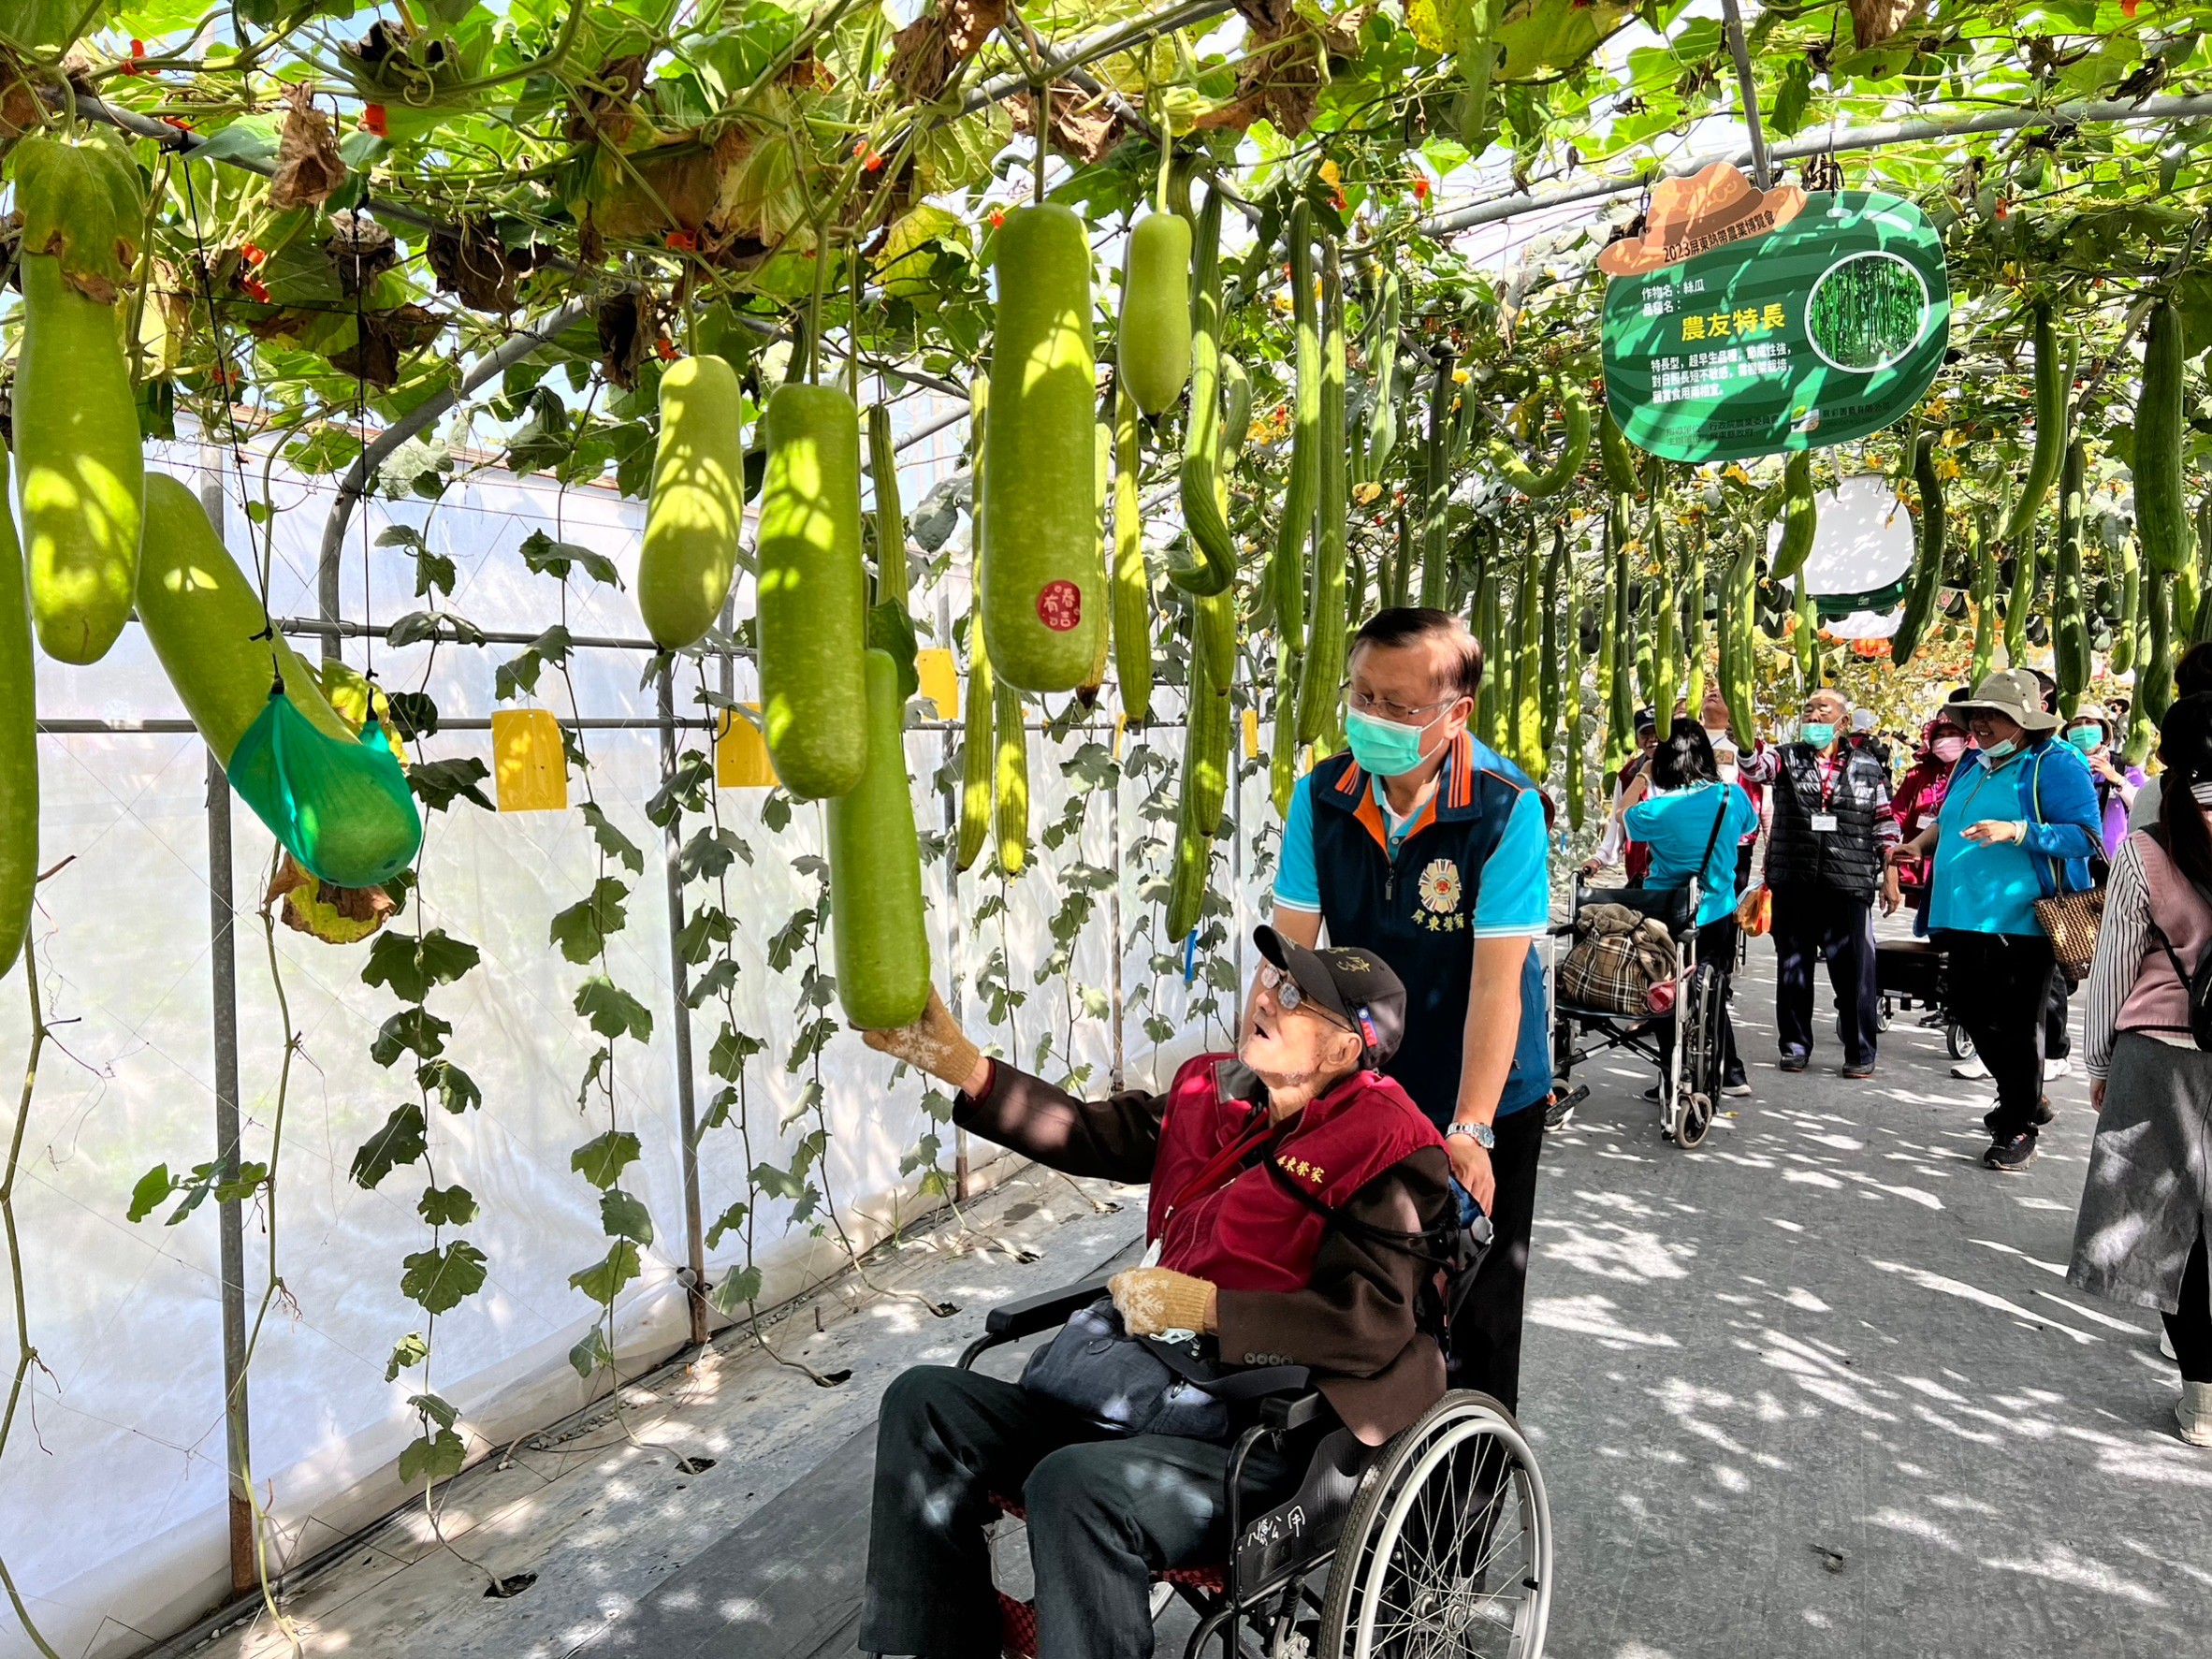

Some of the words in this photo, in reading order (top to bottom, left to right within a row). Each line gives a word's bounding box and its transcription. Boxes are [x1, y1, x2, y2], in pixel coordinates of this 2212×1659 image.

[1663, 210, 1775, 263] 2023屏東熱帶農業博覽會
[1681, 302, 1785, 342] 農友特長
